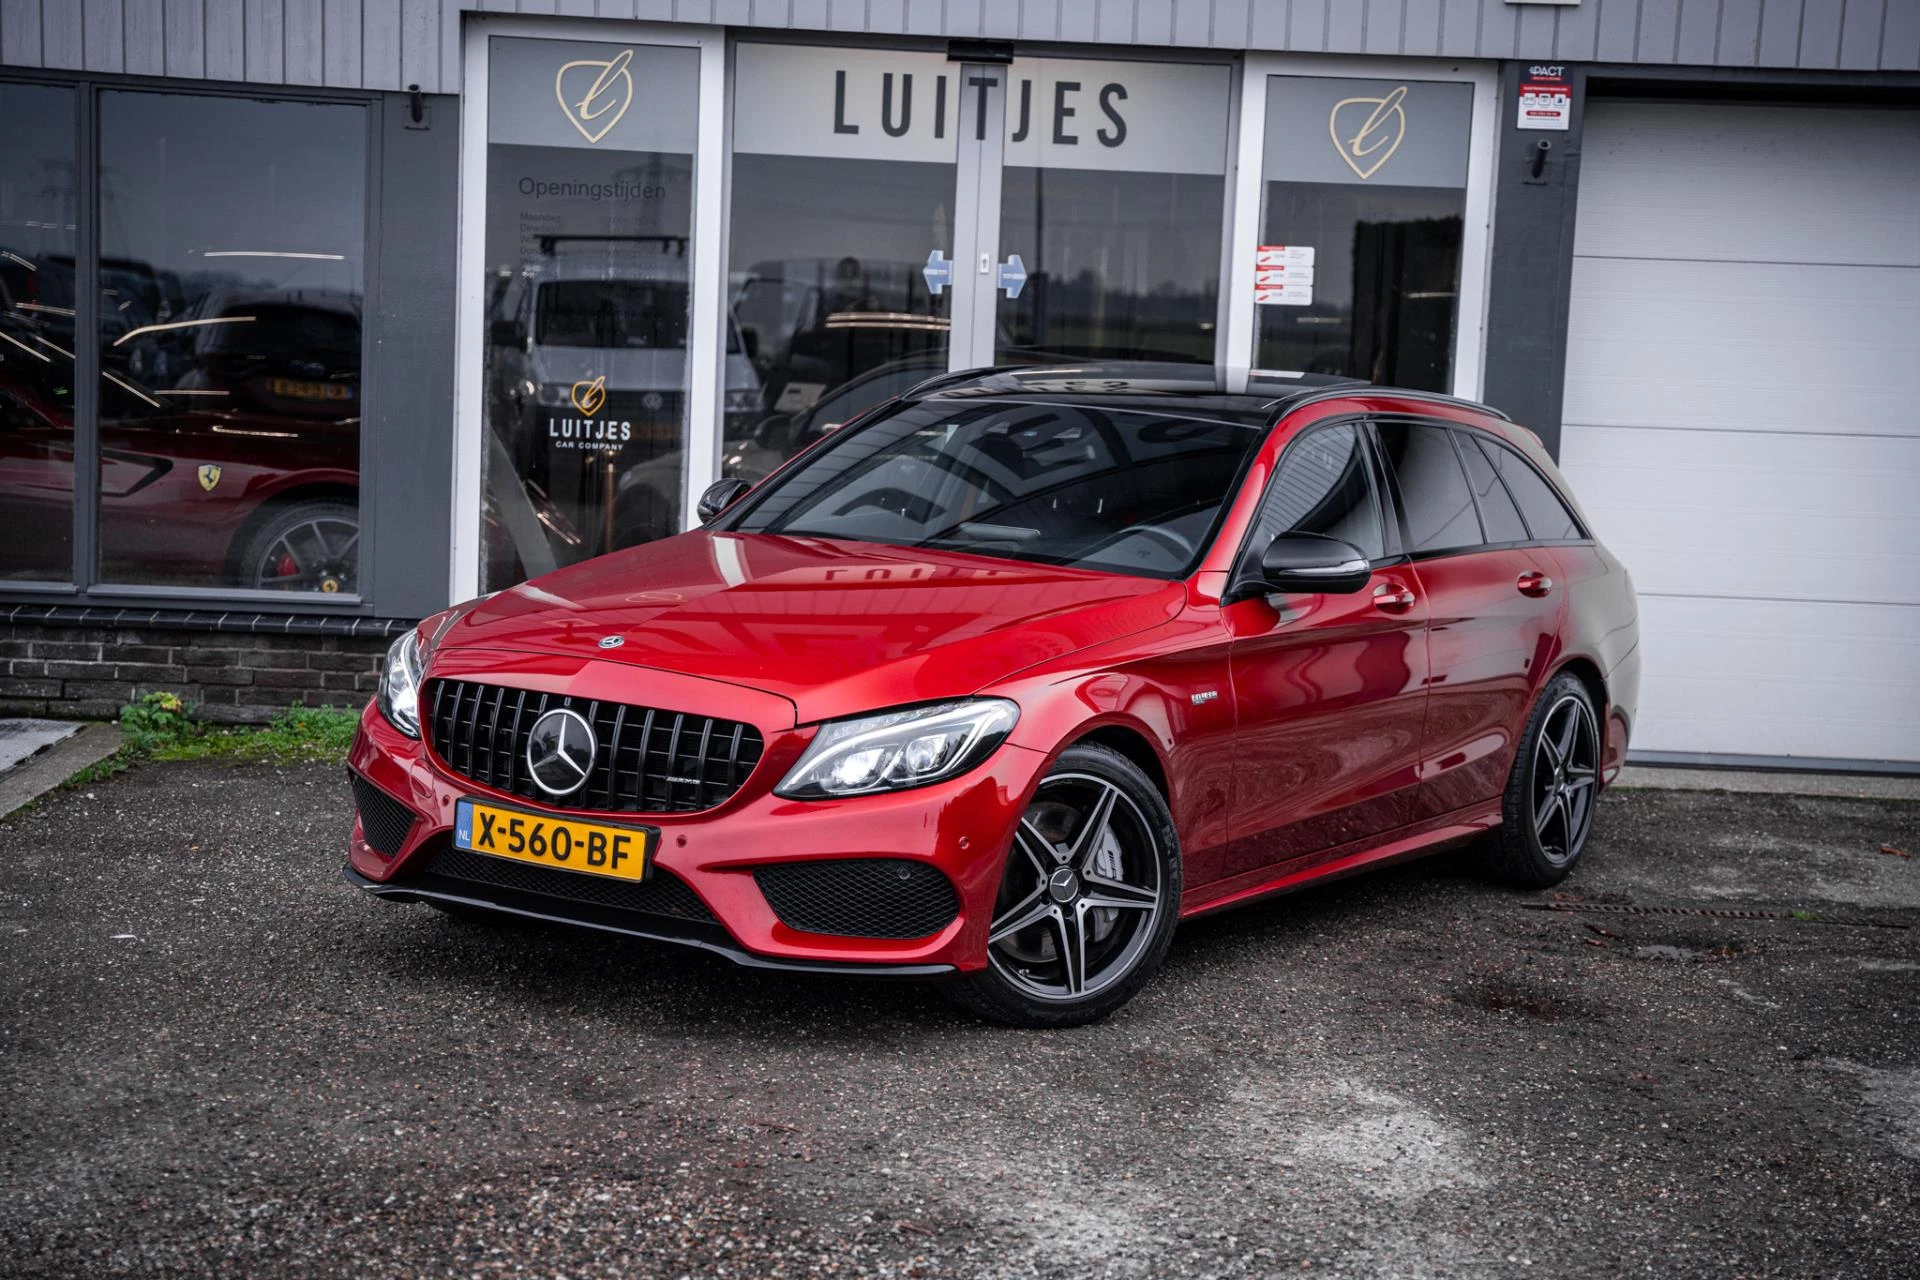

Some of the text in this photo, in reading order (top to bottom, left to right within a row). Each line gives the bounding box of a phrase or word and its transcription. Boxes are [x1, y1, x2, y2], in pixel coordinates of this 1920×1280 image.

[833, 70, 1129, 148] LUITJES
[518, 177, 666, 201] Openingstijden
[549, 418, 631, 440] LUITJES
[578, 442, 624, 450] COMPANY
[458, 830, 471, 841] NL
[478, 812, 631, 869] X-560-BF
